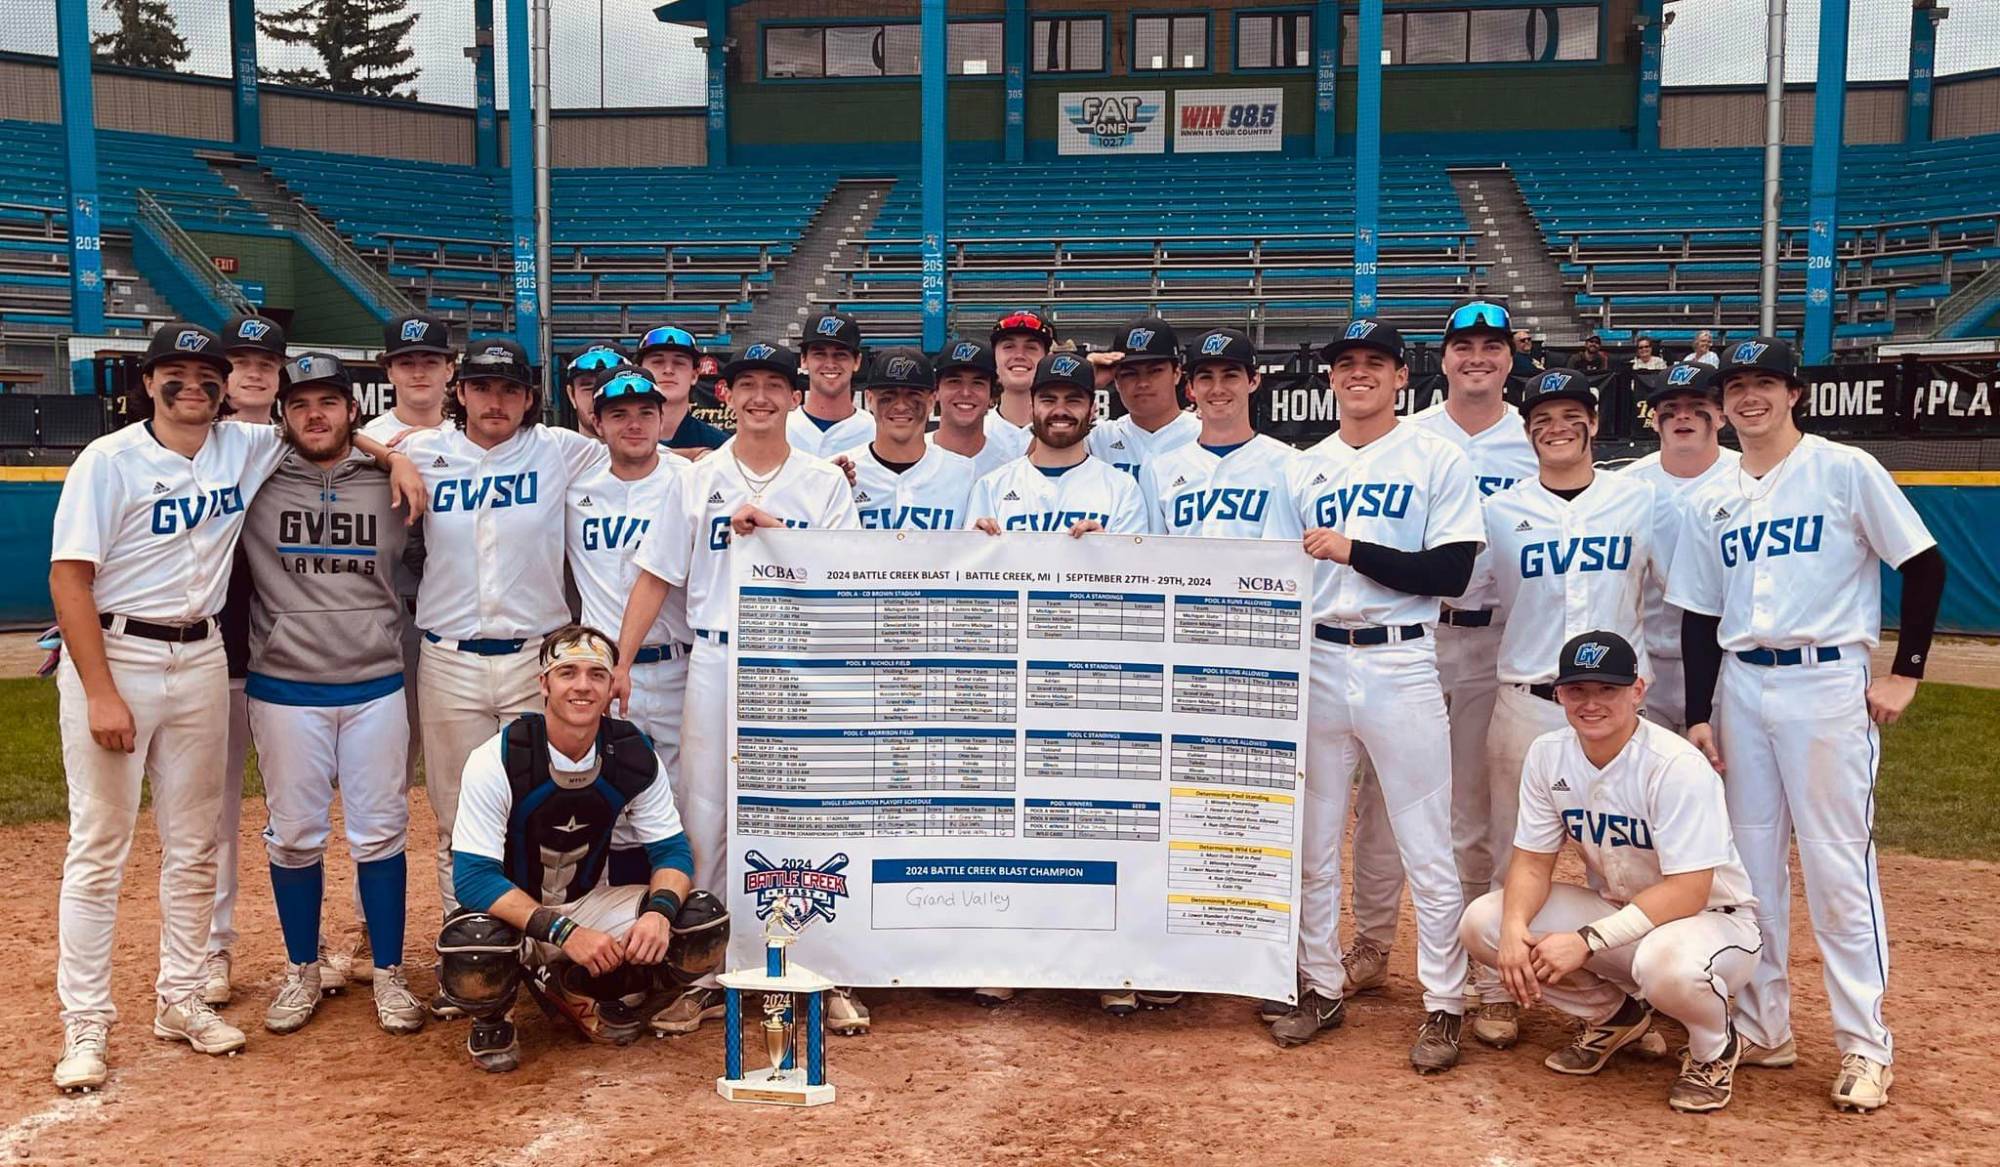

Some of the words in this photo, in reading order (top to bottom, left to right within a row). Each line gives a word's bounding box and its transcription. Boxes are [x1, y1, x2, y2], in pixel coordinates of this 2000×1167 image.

[1642, 70, 1658, 80] 306
[1083, 97, 1142, 123] FAT
[1181, 105, 1225, 128] WIN
[1229, 104, 1277, 127] 98.5
[1097, 123, 1126, 134] ONE
[1237, 128, 1272, 136] COUNTRY
[1099, 138, 1125, 147] 102.7
[76, 236, 100, 250] 203
[215, 258, 234, 270] EXIT
[514, 262, 536, 272] 204
[923, 260, 943, 272] 205
[1355, 262, 1376, 274] 205
[1808, 256, 1832, 268] 206
[516, 277, 536, 288] 203
[922, 276, 944, 288] 204
[239, 320, 269, 340] GV
[401, 319, 429, 342] GV
[816, 315, 845, 336] GV
[1344, 320, 1378, 340] GV
[175, 331, 209, 352] GV
[1127, 328, 1155, 351] GV
[1202, 334, 1232, 355] GV
[744, 344, 776, 360] GV
[952, 342, 981, 361] GV
[1732, 341, 1768, 364] GV
[1050, 355, 1080, 377] GV
[1668, 364, 1700, 385] GV
[1539, 372, 1571, 393] GV
[1174, 488, 1270, 527] GVSU
[1316, 484, 1414, 528] GVSU
[859, 506, 954, 529] GVSU
[280, 511, 377, 546] GVSU
[1720, 514, 1824, 568] GVSU
[283, 558, 375, 576] LAKERS
[1521, 536, 1633, 579] GVSU
[752, 565, 795, 580] NCBA
[827, 572, 850, 580] 2024
[853, 572, 887, 580] BATTLE
[890, 571, 919, 579] CREEK
[922, 571, 949, 580] BLAST
[966, 572, 1000, 580] BATTLE
[1003, 573, 1036, 582] CREEK,
[1038, 573, 1050, 581] MI
[1066, 573, 1122, 583] SEPTEMBER
[1125, 575, 1149, 583] 27TH
[1158, 575, 1185, 586] 29TH,
[1187, 577, 1211, 586] 2024
[1238, 577, 1284, 591] NCBA
[1574, 641, 1609, 670] GV
[1196, 791, 1230, 799] Determining
[1560, 808, 1654, 850] GVSU
[782, 858, 812, 869] 2024
[906, 866, 928, 875] 2024
[930, 866, 965, 875] BATTLE
[967, 866, 996, 876] CREEK
[999, 867, 1028, 876] BLAST
[1030, 867, 1083, 877] CHAMPION
[747, 870, 799, 891] BATTLE
[802, 870, 845, 894] CREEK
[777, 889, 815, 897] BLAST
[906, 887, 955, 908] Grand
[962, 887, 1010, 912] Valley
[763, 994, 791, 1008] 2024
